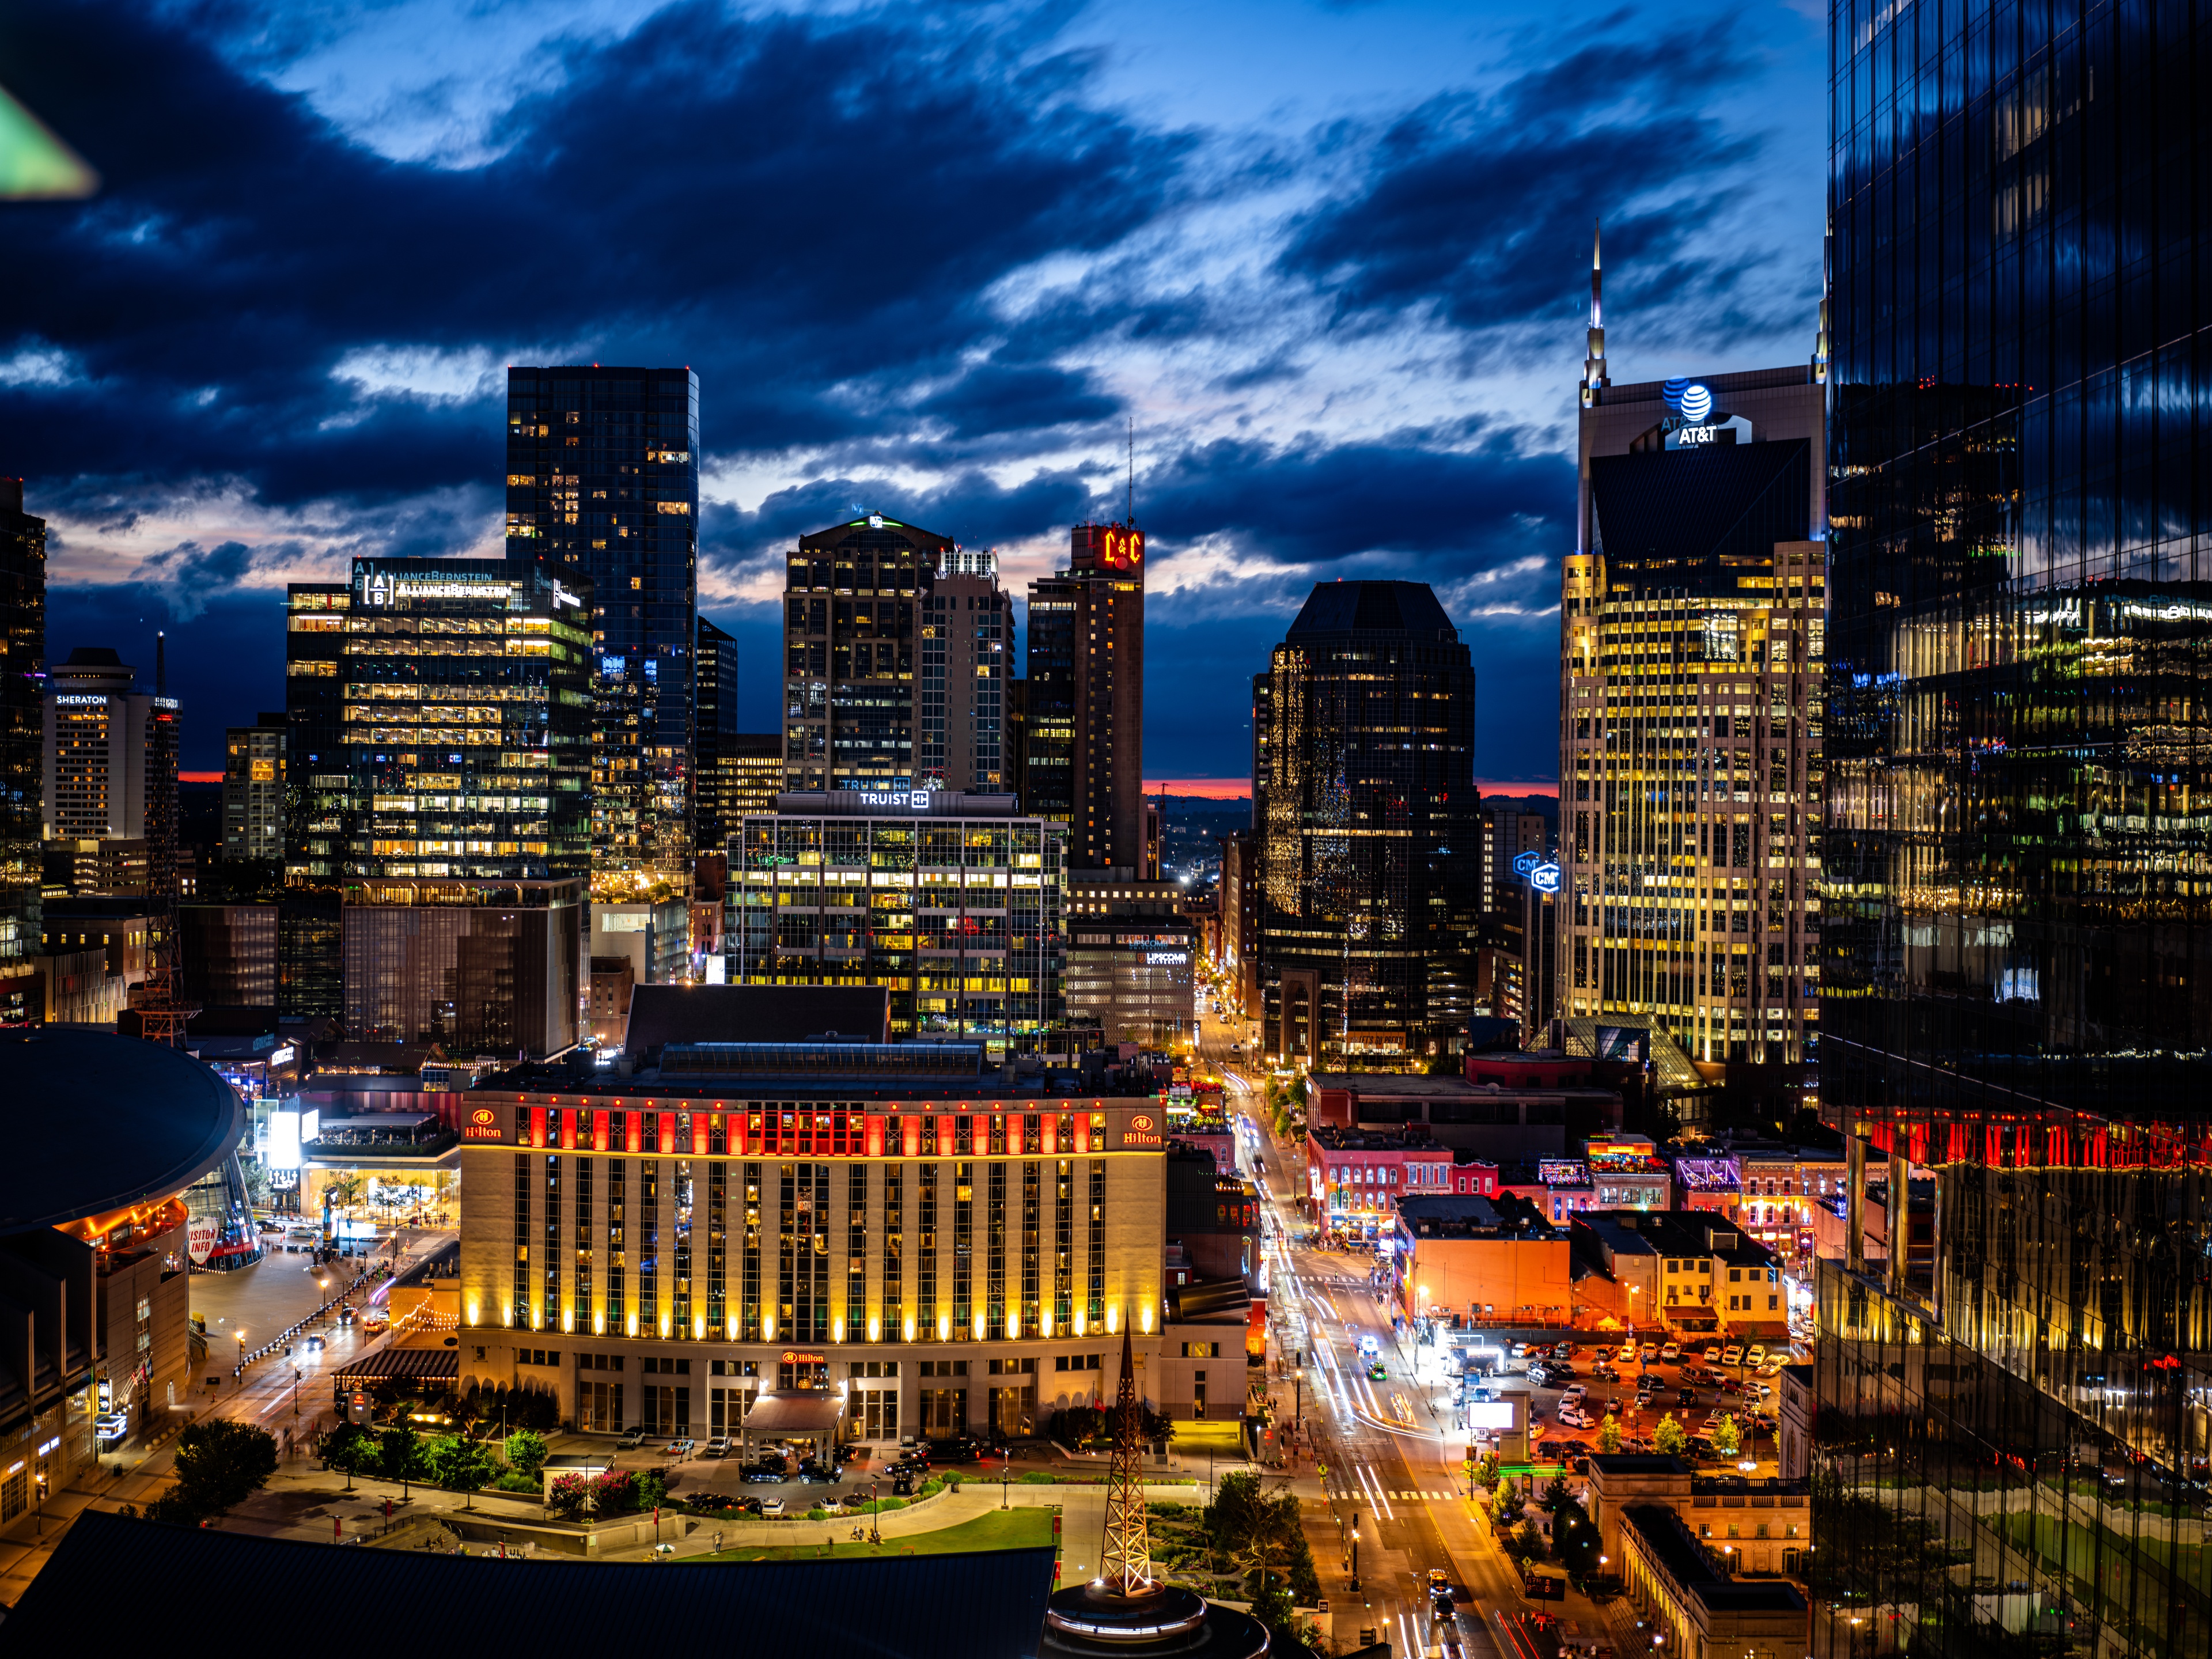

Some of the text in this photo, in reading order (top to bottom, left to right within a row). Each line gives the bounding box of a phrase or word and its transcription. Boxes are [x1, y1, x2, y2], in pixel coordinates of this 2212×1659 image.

[1679, 426, 1717, 444] AT&T
[57, 696, 107, 704] SHERATON
[860, 793, 909, 805] TRUIST
[1147, 953, 1187, 961] LIPSCOMB
[1375, 1036, 1382, 1045] GO
[465, 1126, 501, 1138] Hilton
[1124, 1132, 1162, 1143] Hilton
[191, 1241, 210, 1253] INFO
[224, 1245, 243, 1254] NASHVILLE
[798, 1353, 824, 1362] Hilton
